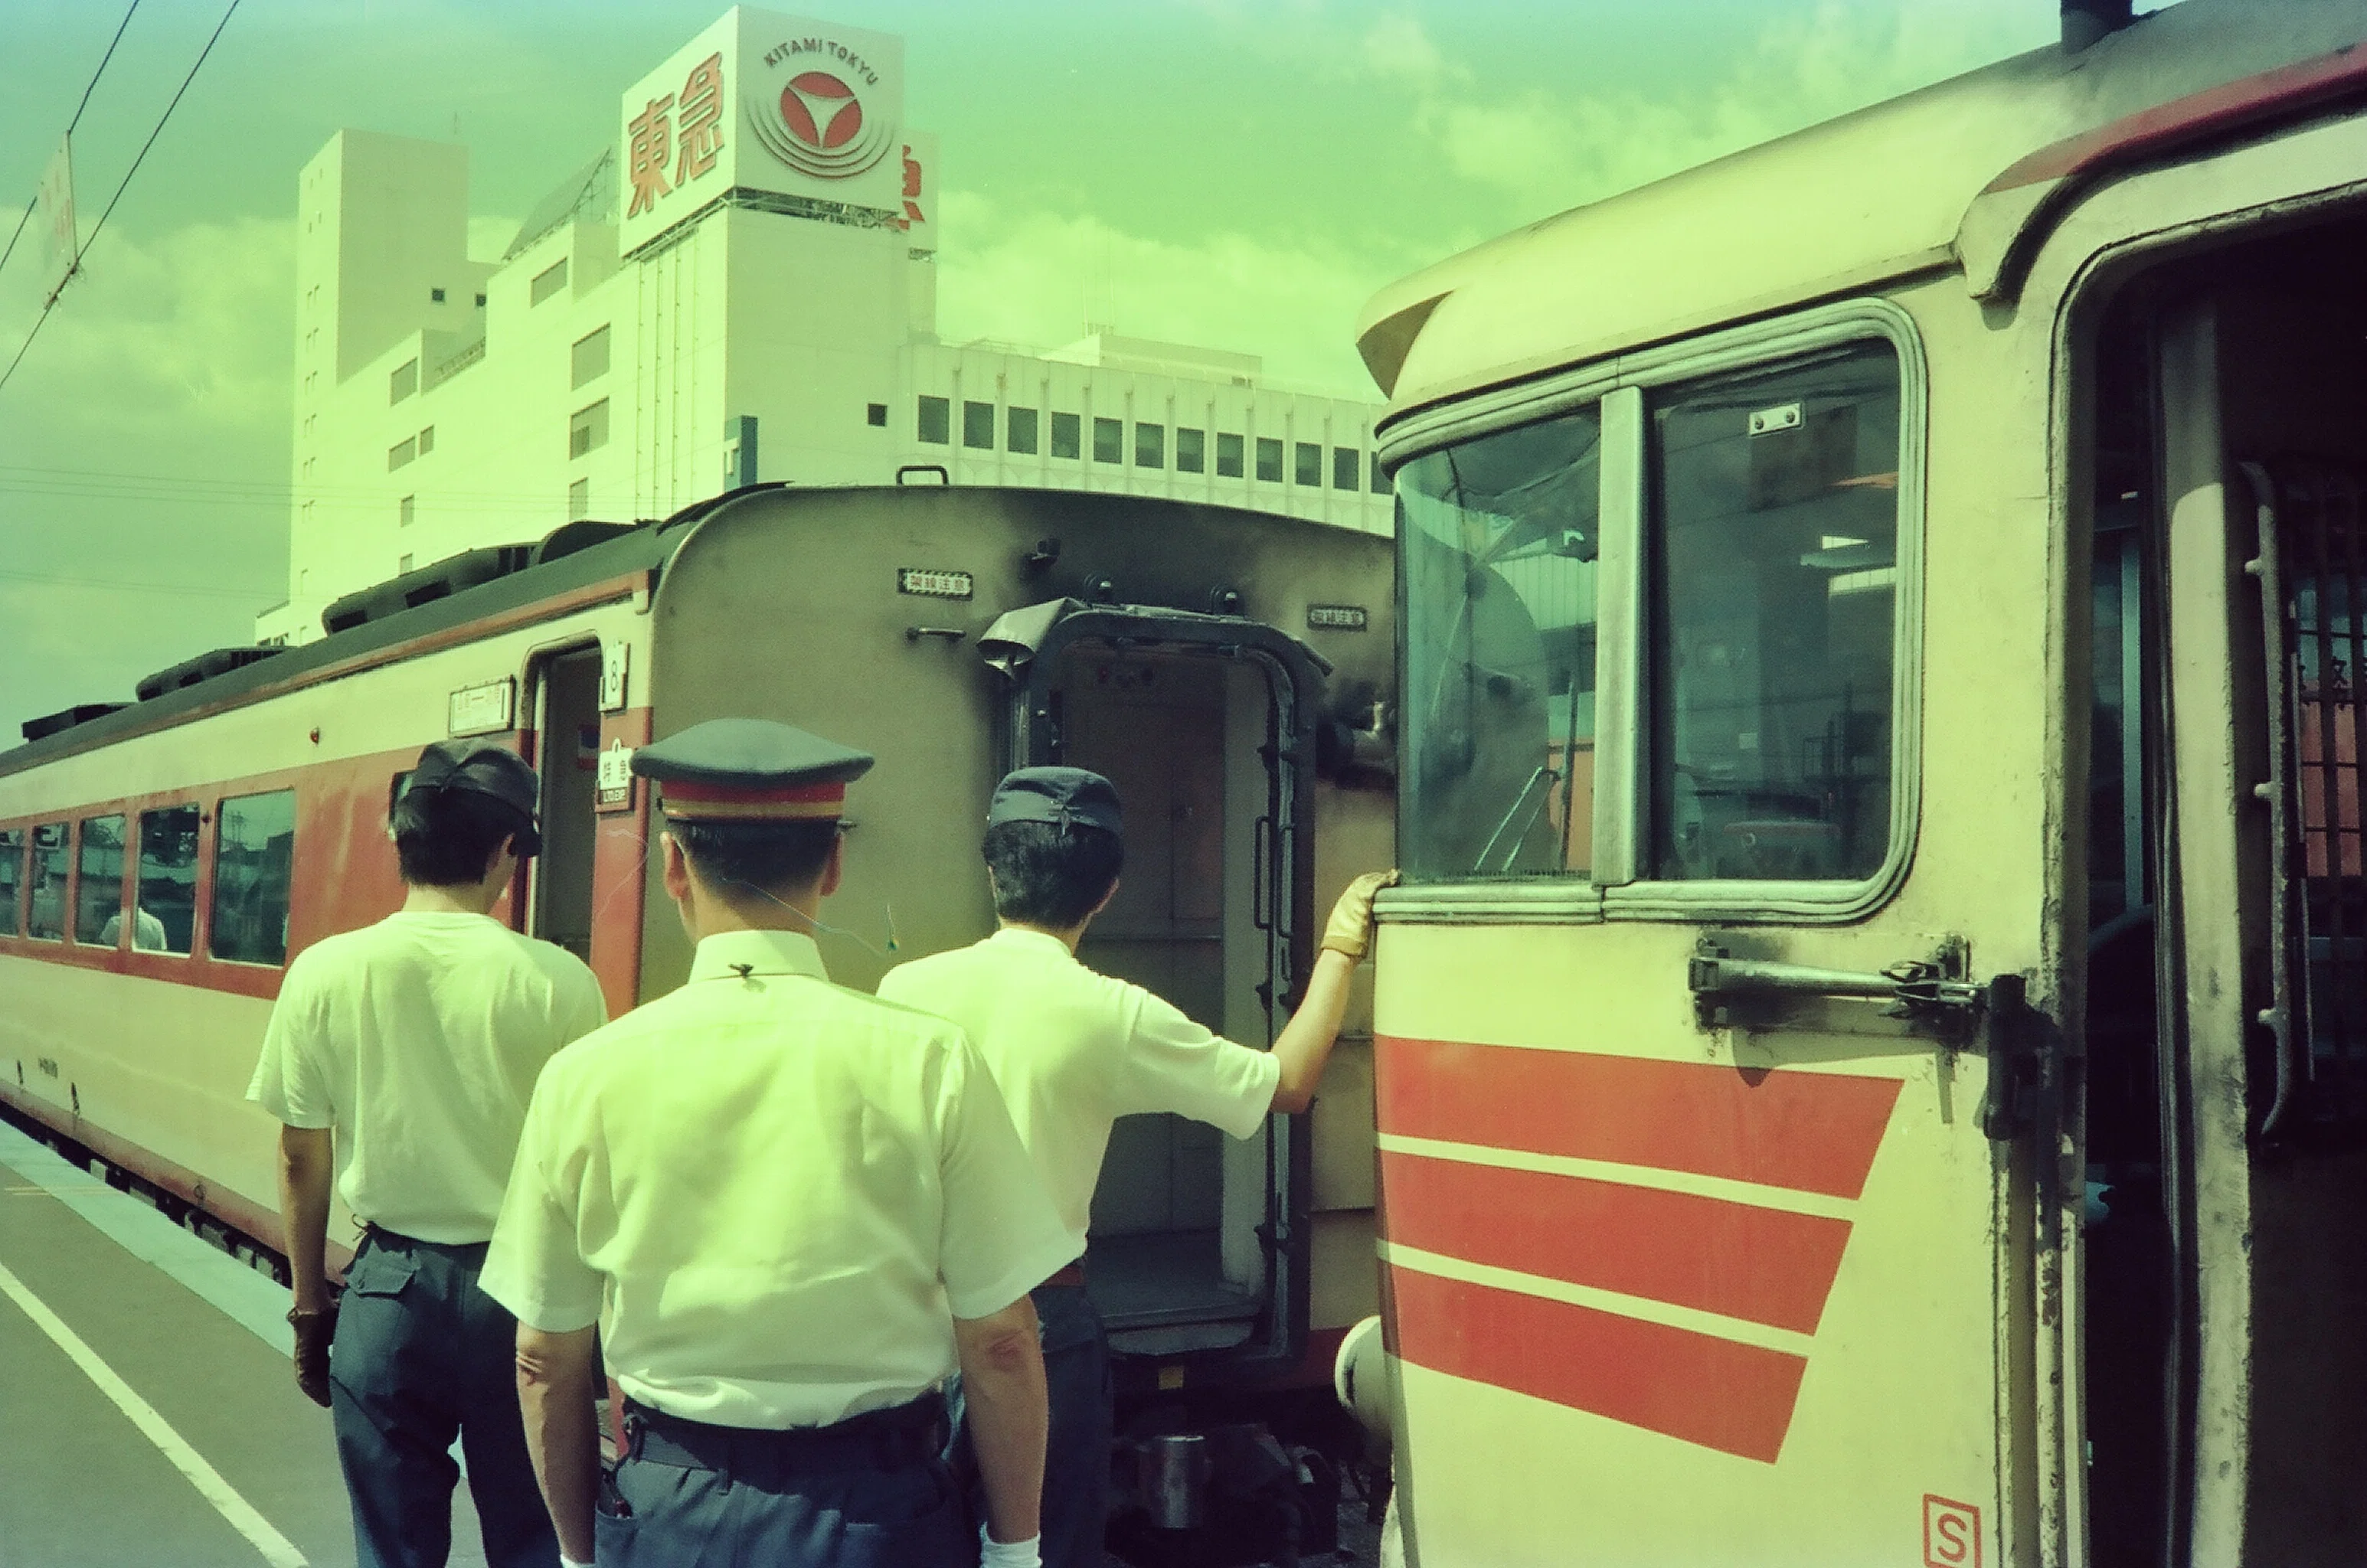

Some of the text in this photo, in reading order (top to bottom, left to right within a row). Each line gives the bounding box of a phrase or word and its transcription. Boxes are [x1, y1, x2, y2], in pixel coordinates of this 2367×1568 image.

[764, 38, 878, 85] KITAMI TOKYU
[627, 51, 724, 220] 東急
[1937, 1513, 1967, 1563] S
